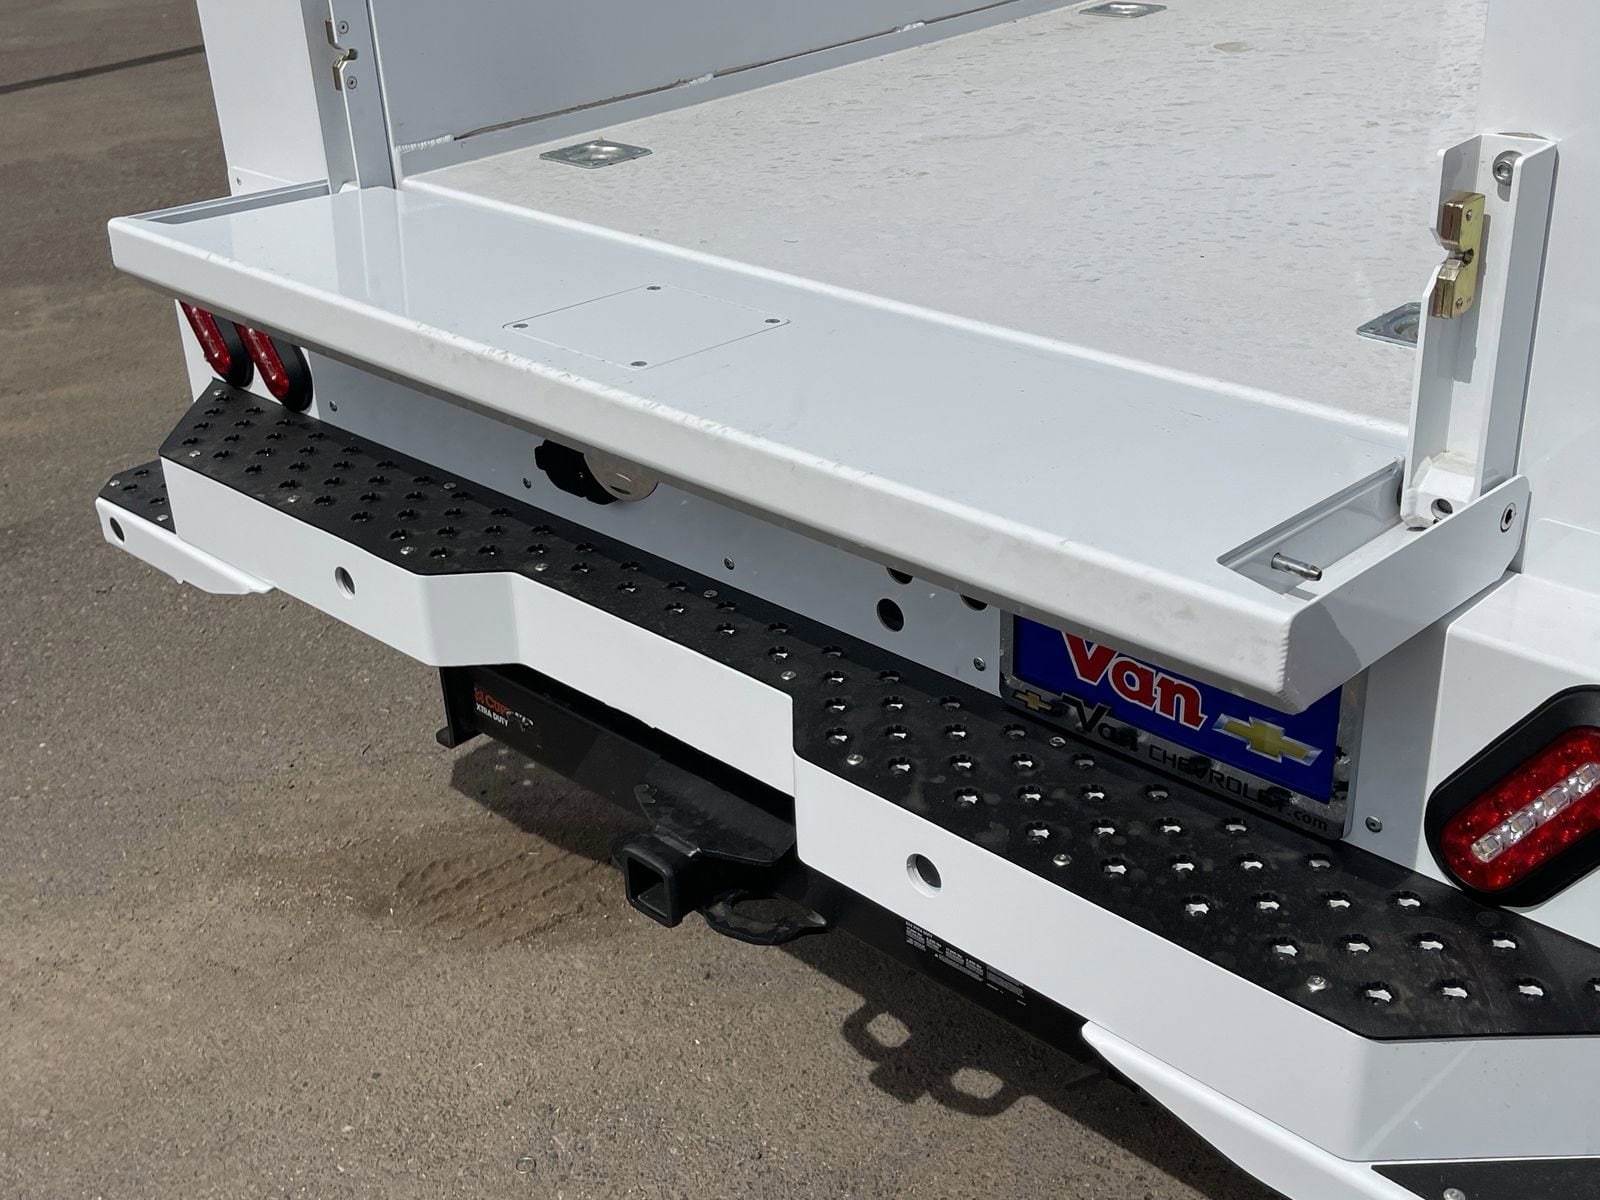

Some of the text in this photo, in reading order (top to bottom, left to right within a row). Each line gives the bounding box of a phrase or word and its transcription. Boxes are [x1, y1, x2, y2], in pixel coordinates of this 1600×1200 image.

[1062, 631, 1208, 730] Van
[492, 711, 509, 727] DUTY
[1060, 692, 1140, 752] Van
